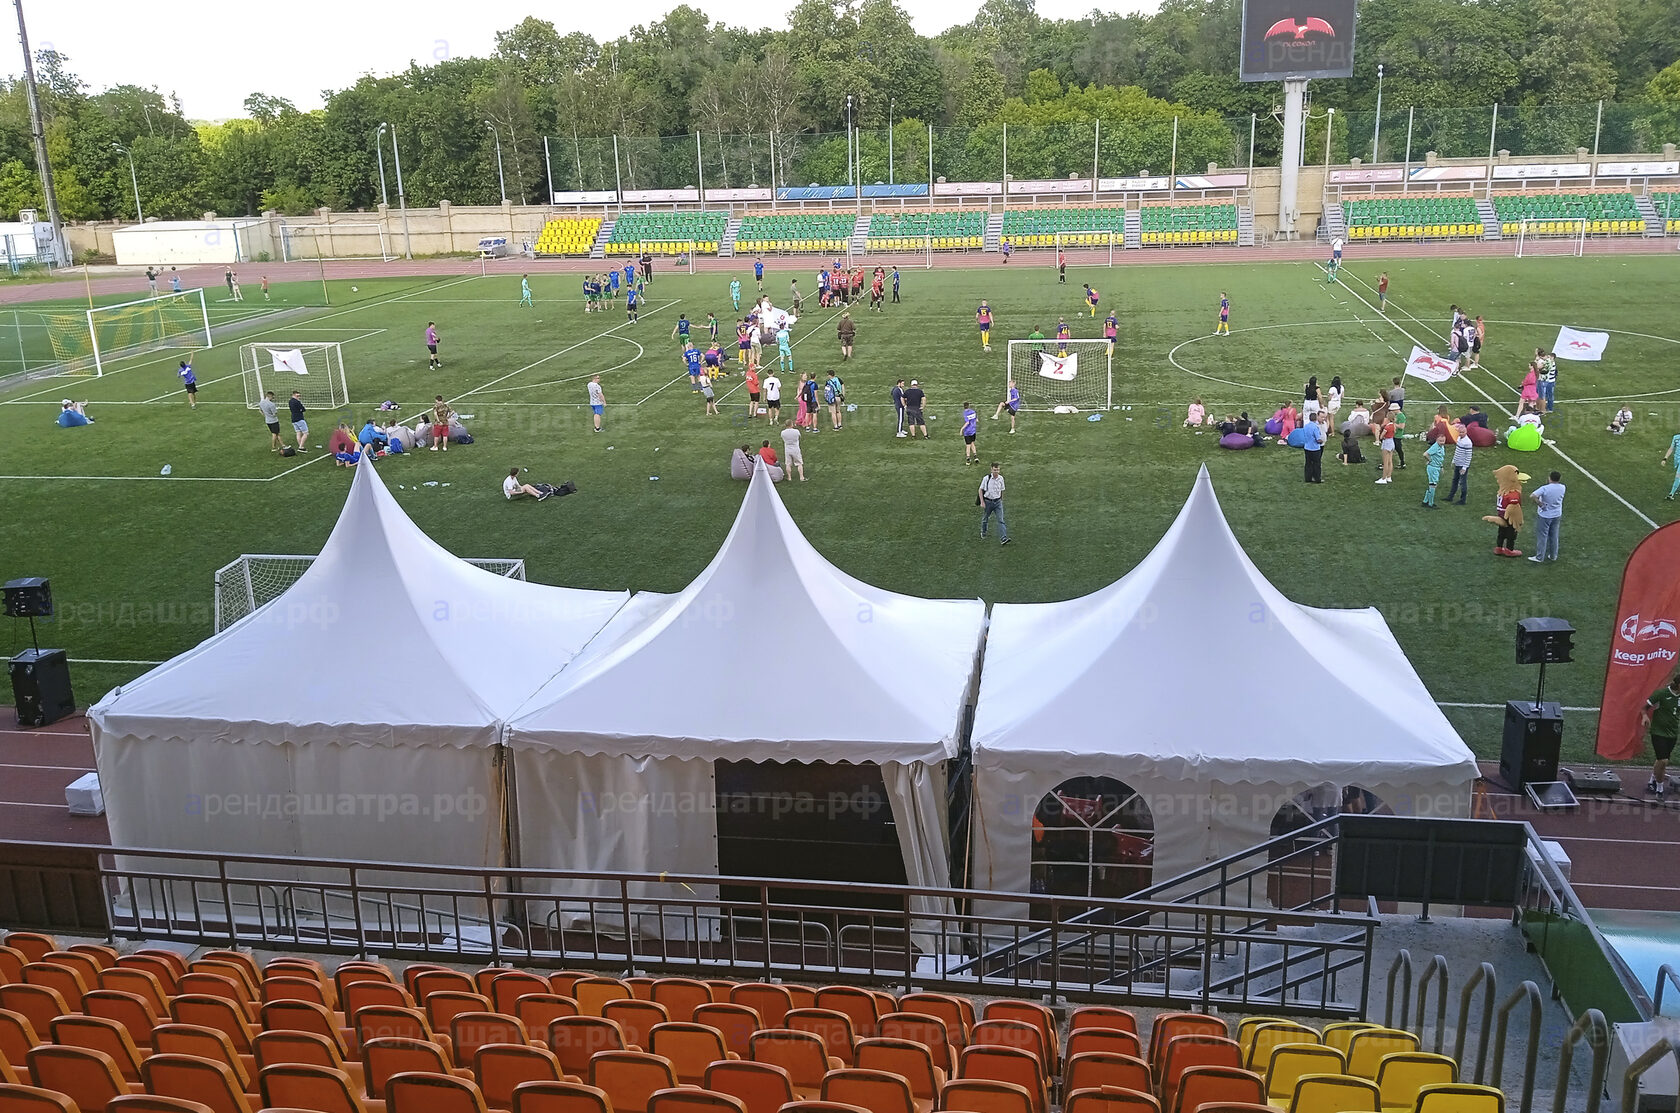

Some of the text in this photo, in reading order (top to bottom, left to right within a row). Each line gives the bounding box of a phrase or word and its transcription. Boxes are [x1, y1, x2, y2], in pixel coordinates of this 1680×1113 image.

[1053, 361, 1064, 375] 2
[768, 382, 775, 391] 7
[1614, 648, 1677, 663] keep unity
